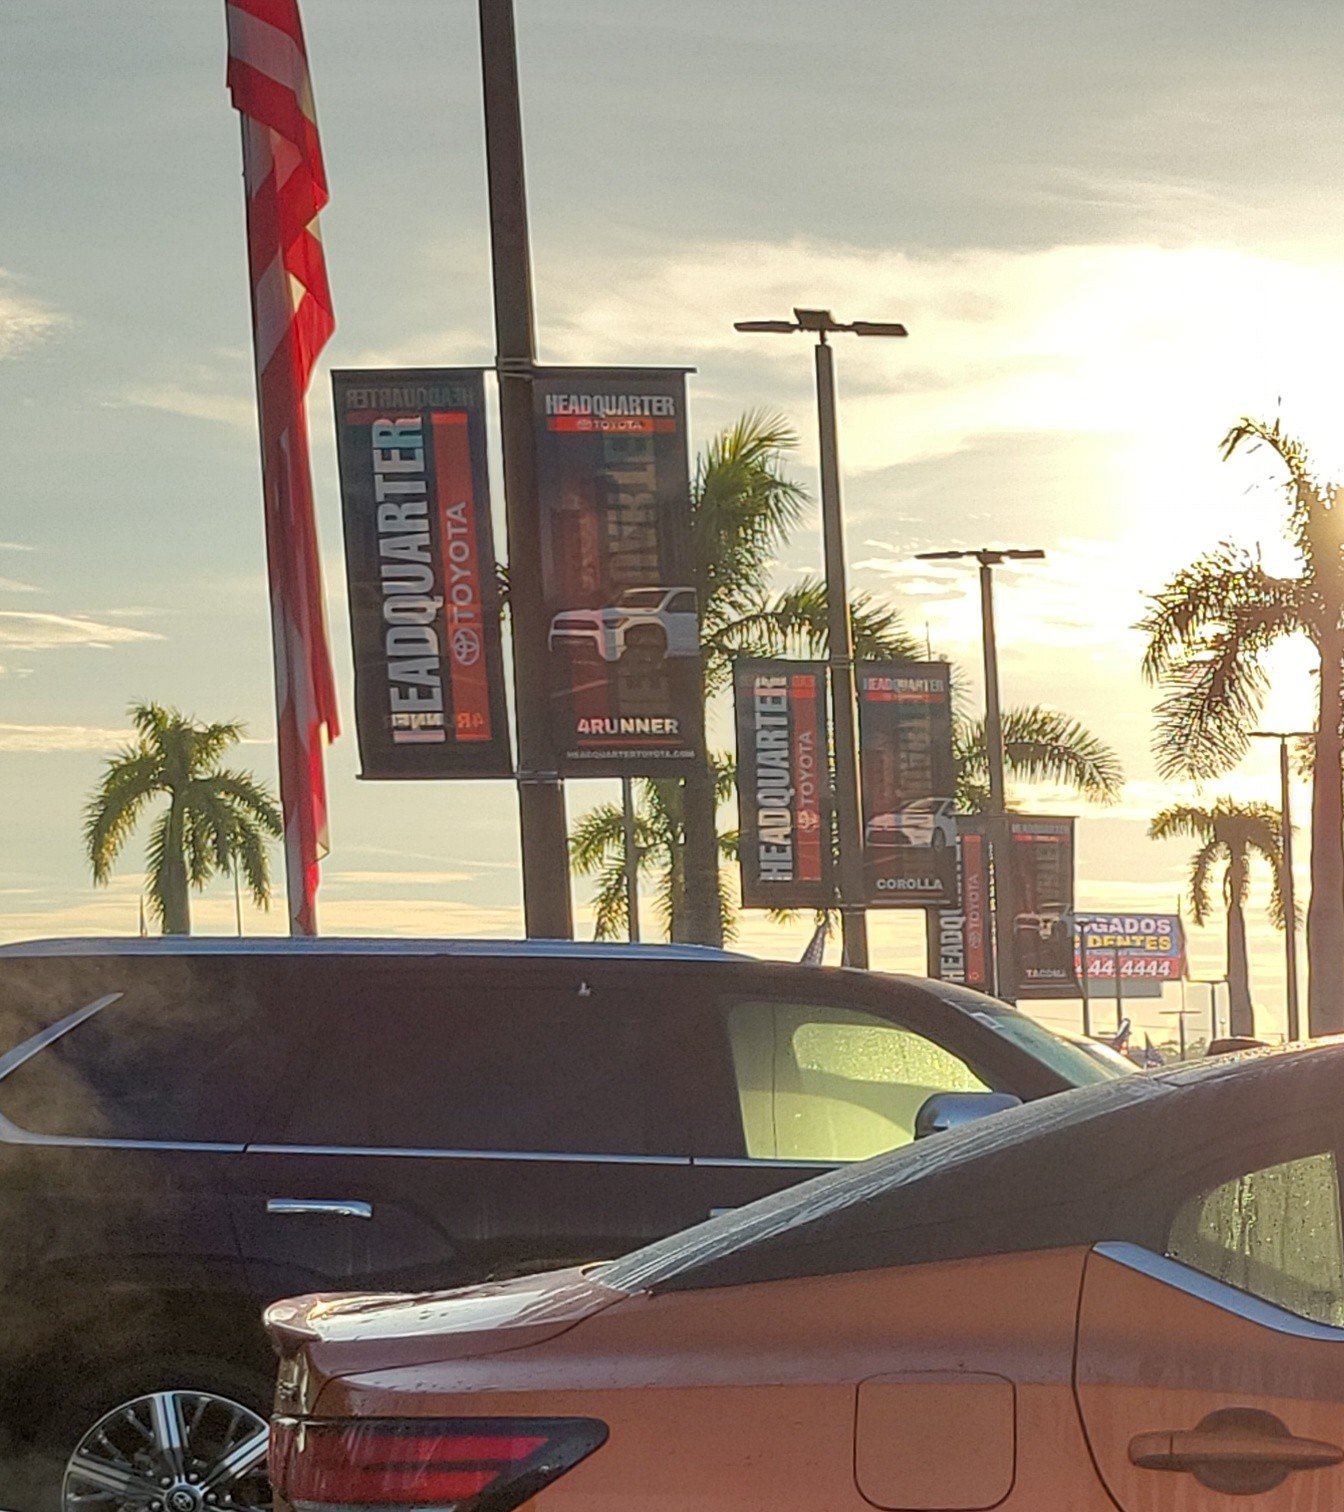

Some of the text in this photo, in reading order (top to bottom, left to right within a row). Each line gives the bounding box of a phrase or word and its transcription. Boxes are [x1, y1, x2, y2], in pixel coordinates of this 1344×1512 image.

[545, 394, 675, 417] HEADQUARTER
[594, 419, 643, 430] TOYOTA
[371, 417, 446, 743] HEADQUARTER
[447, 501, 475, 623] TOYOTA
[577, 718, 679, 734] 4RUNNER
[753, 675, 794, 883] HEADQUARTER
[797, 730, 816, 810] TOYOTA
[876, 878, 944, 890] COROLLA
[968, 874, 981, 929] TOYOTA
